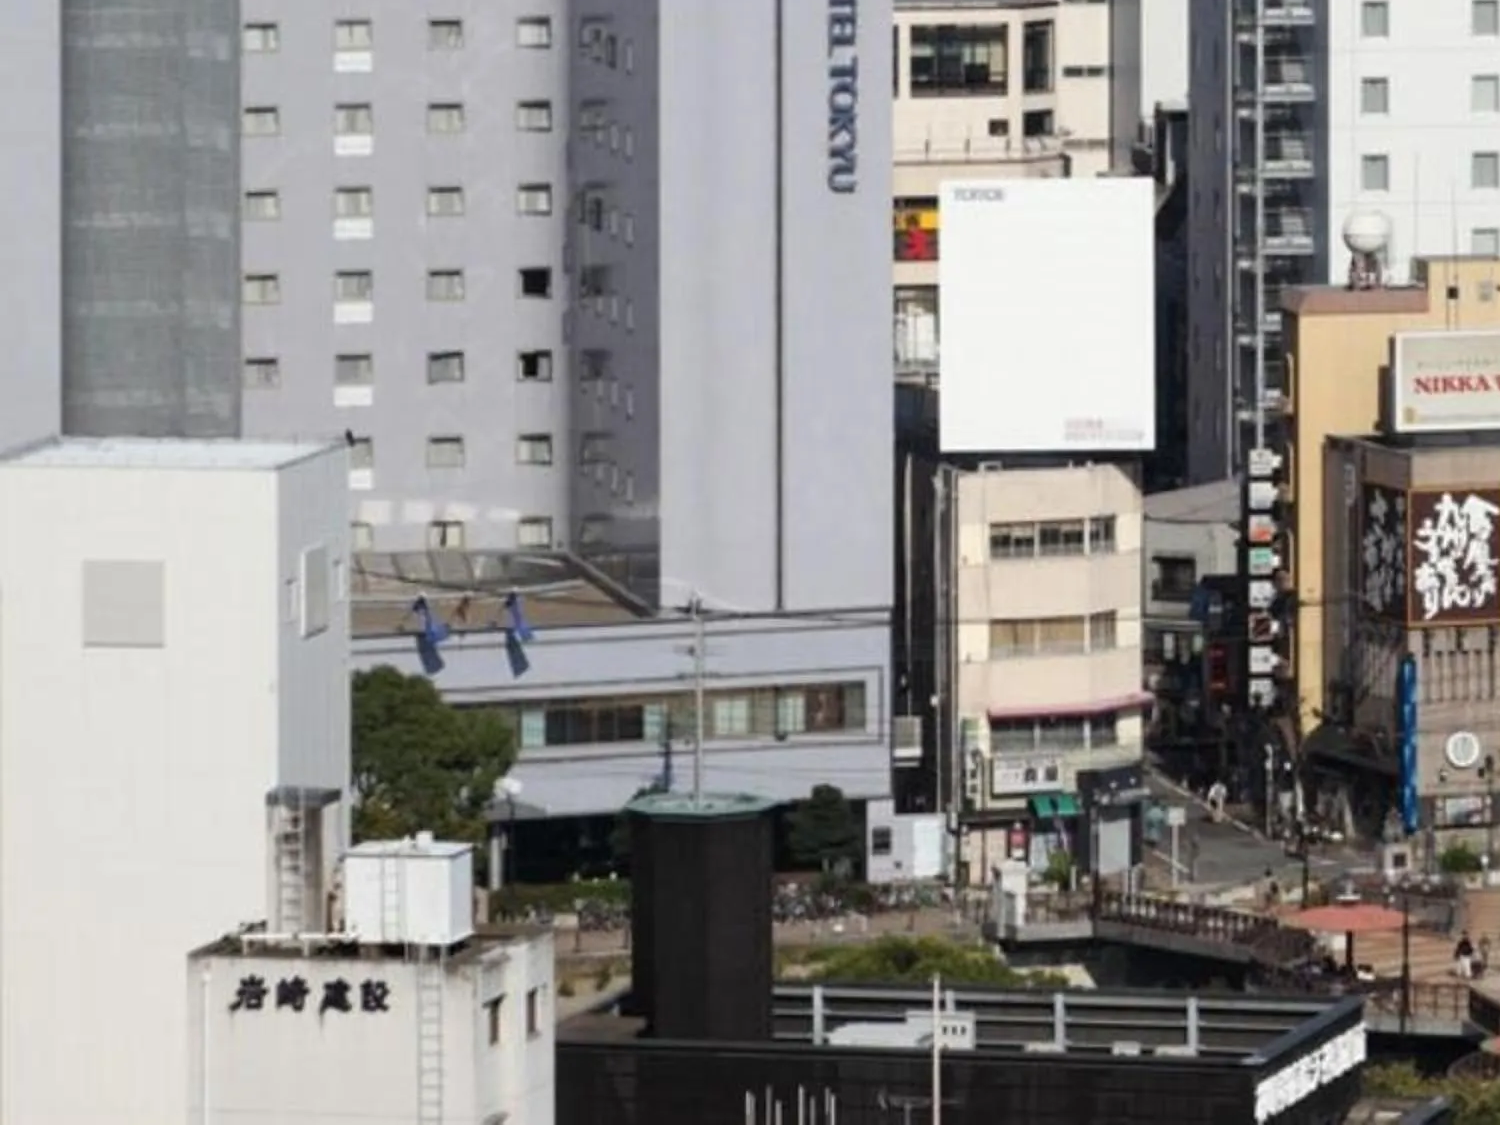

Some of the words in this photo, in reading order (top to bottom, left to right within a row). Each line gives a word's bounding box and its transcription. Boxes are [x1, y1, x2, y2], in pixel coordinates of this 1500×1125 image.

[827, 57, 858, 194] TOKYU
[1413, 376, 1492, 395] NIKKA
[229, 973, 391, 1016] 岩崎建設
